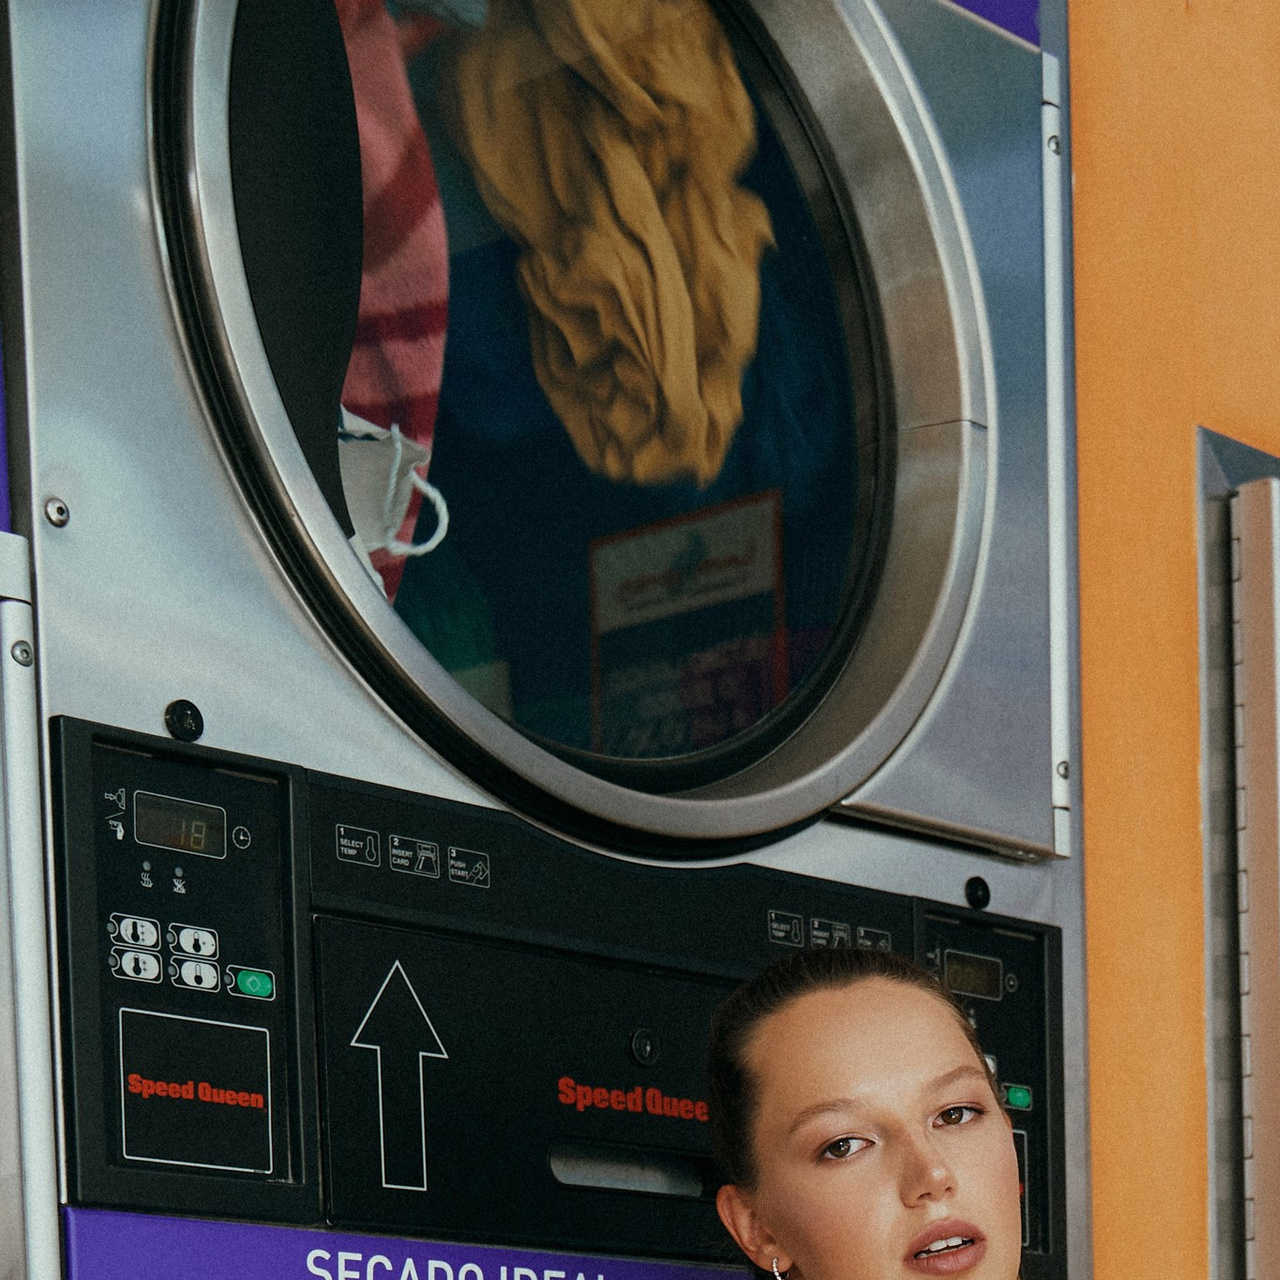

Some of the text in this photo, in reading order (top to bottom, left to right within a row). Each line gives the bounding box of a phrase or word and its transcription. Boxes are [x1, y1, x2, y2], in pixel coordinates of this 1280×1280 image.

[340, 827, 346, 835] 1
[340, 838, 364, 849] SELECT
[393, 838, 400, 846] 2
[340, 847, 358, 856] TEMP
[391, 848, 413, 858] INSERT
[450, 849, 457, 857] 3
[392, 857, 410, 867] CARD
[450, 860, 467, 869] PUSH
[450, 868, 469, 878] START
[127, 1073, 264, 1109] Speed Queen
[557, 1076, 710, 1122] Speed Quee
